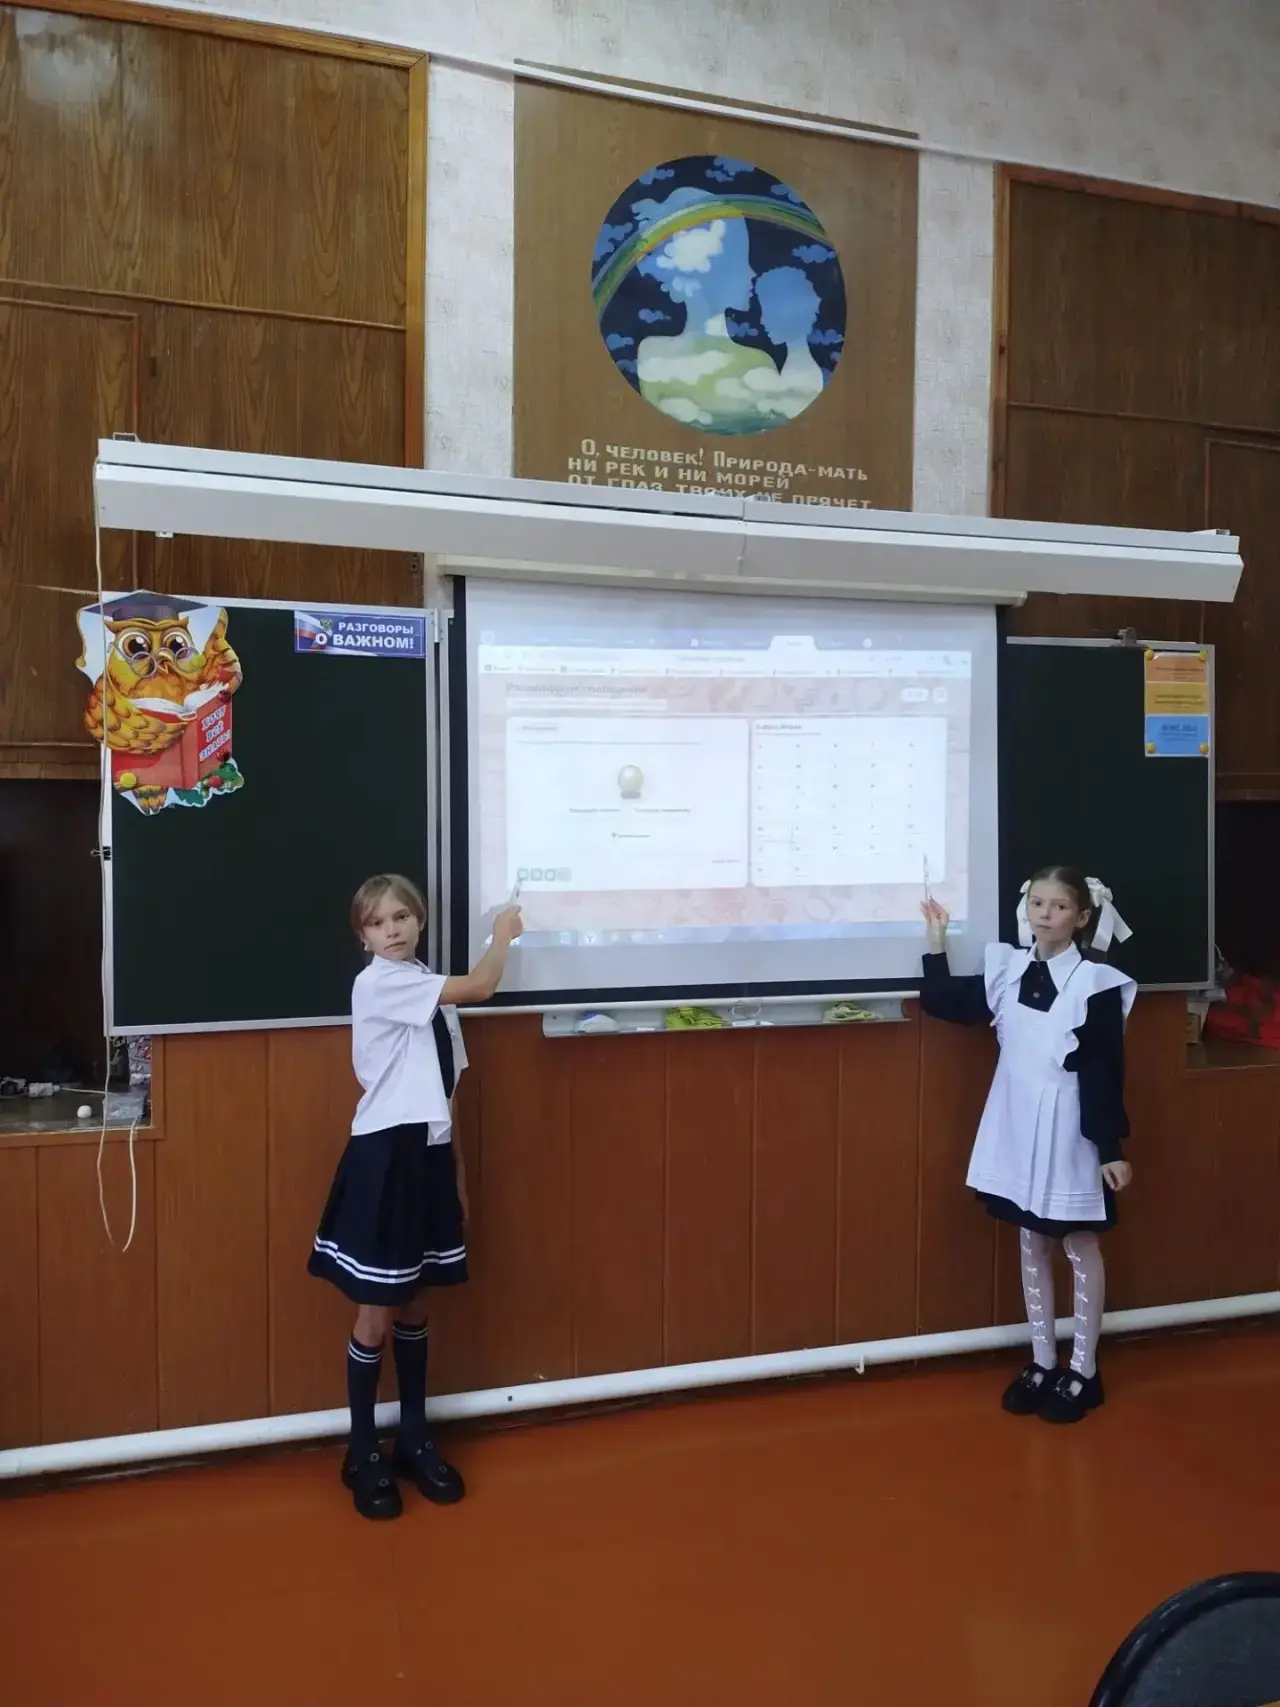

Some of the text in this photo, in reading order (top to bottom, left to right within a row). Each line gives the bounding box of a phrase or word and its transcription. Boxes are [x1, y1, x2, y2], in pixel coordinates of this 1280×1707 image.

[581, 438, 600, 458] О,
[605, 444, 704, 465] ЧЕЛОВЕК!
[568, 457, 790, 490] НИ РЕК И НИ МОРЕЙ
[568, 474, 596, 486] ОТ
[338, 622, 414, 634] РАЗГОВОРЫ
[315, 632, 414, 649] О ВАЖНОМ!
